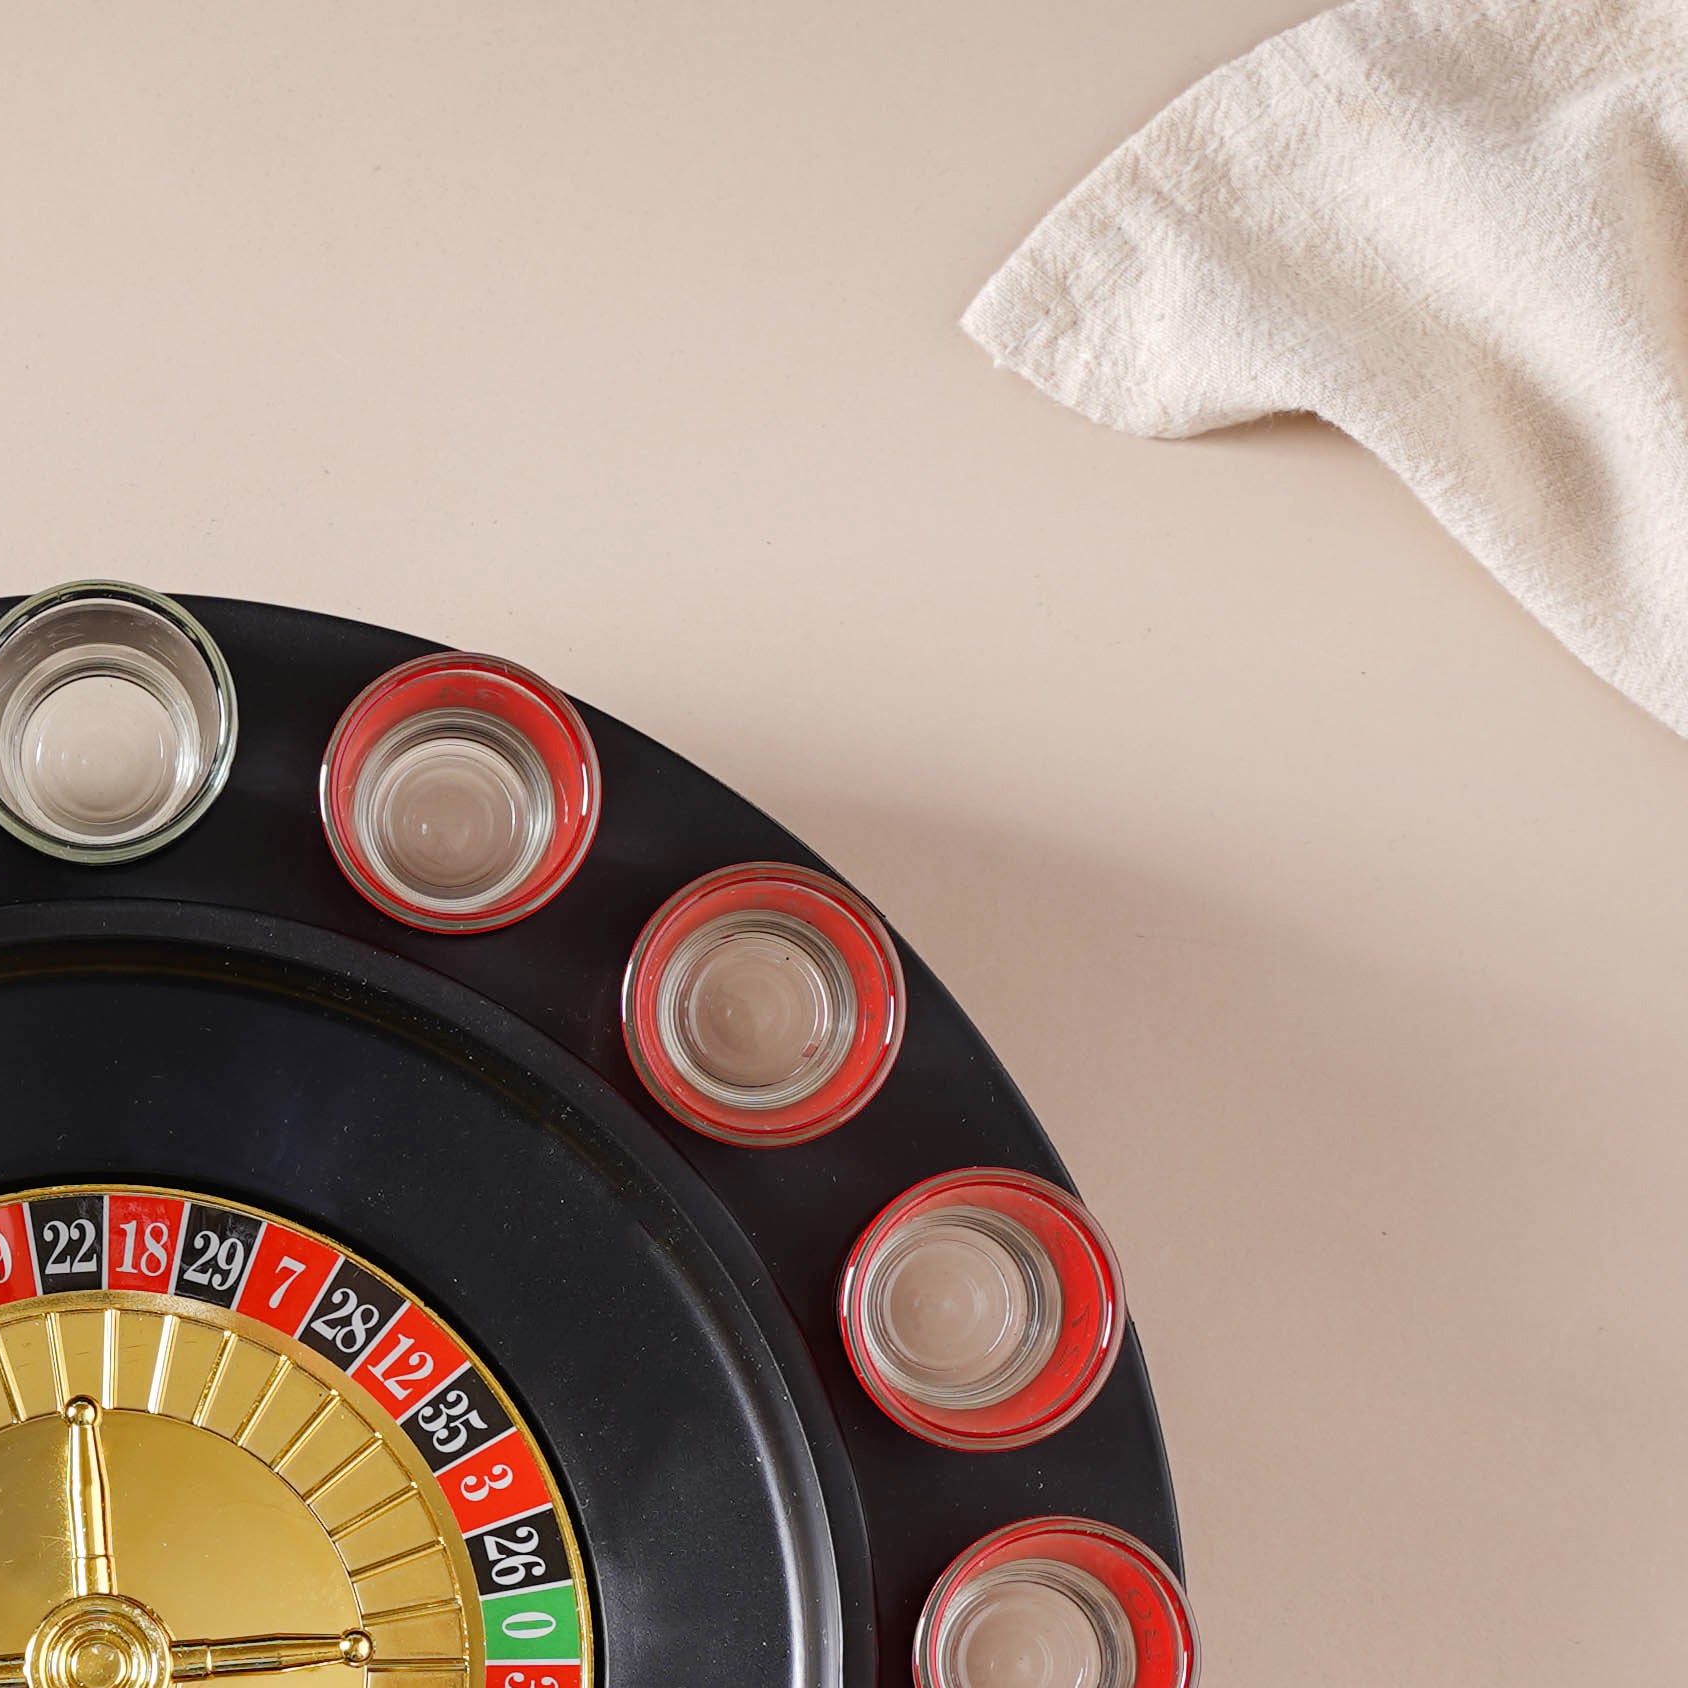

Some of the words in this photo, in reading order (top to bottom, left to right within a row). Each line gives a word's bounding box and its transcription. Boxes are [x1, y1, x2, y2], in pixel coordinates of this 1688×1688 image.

[43, 1218, 98, 1275] 22
[116, 1220, 169, 1277] 18
[183, 1230, 245, 1291] 29
[268, 1255, 306, 1309] 7
[310, 1287, 380, 1353] 28
[367, 1333, 434, 1401] 12
[417, 1390, 488, 1453] 35
[460, 1464, 513, 1502] 3
[483, 1526, 546, 1586] 26
[501, 1611, 557, 1639] 0
